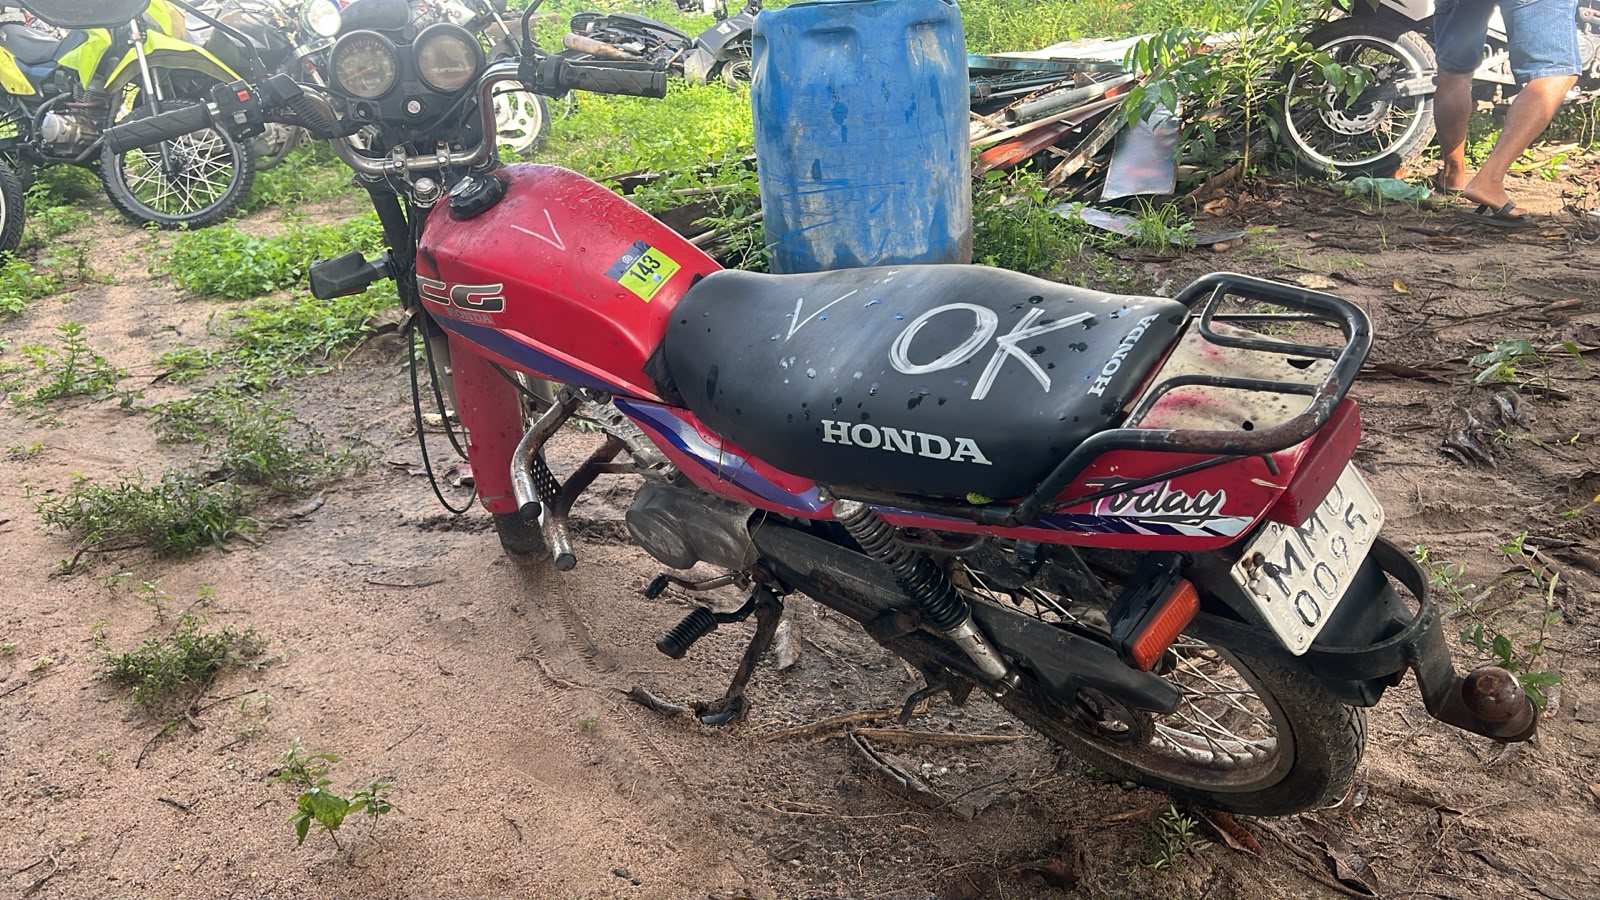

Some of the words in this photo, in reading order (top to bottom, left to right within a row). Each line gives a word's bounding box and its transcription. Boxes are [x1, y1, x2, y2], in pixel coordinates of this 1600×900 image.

[416, 273, 505, 313] CG
[629, 254, 661, 283] 143
[443, 306, 497, 325] HONDA
[887, 302, 1096, 401] OK
[1087, 312, 1160, 398] HONDA
[820, 418, 993, 466] HONDA
[1085, 475, 1227, 527] Today
[1294, 501, 1371, 629] 0095
